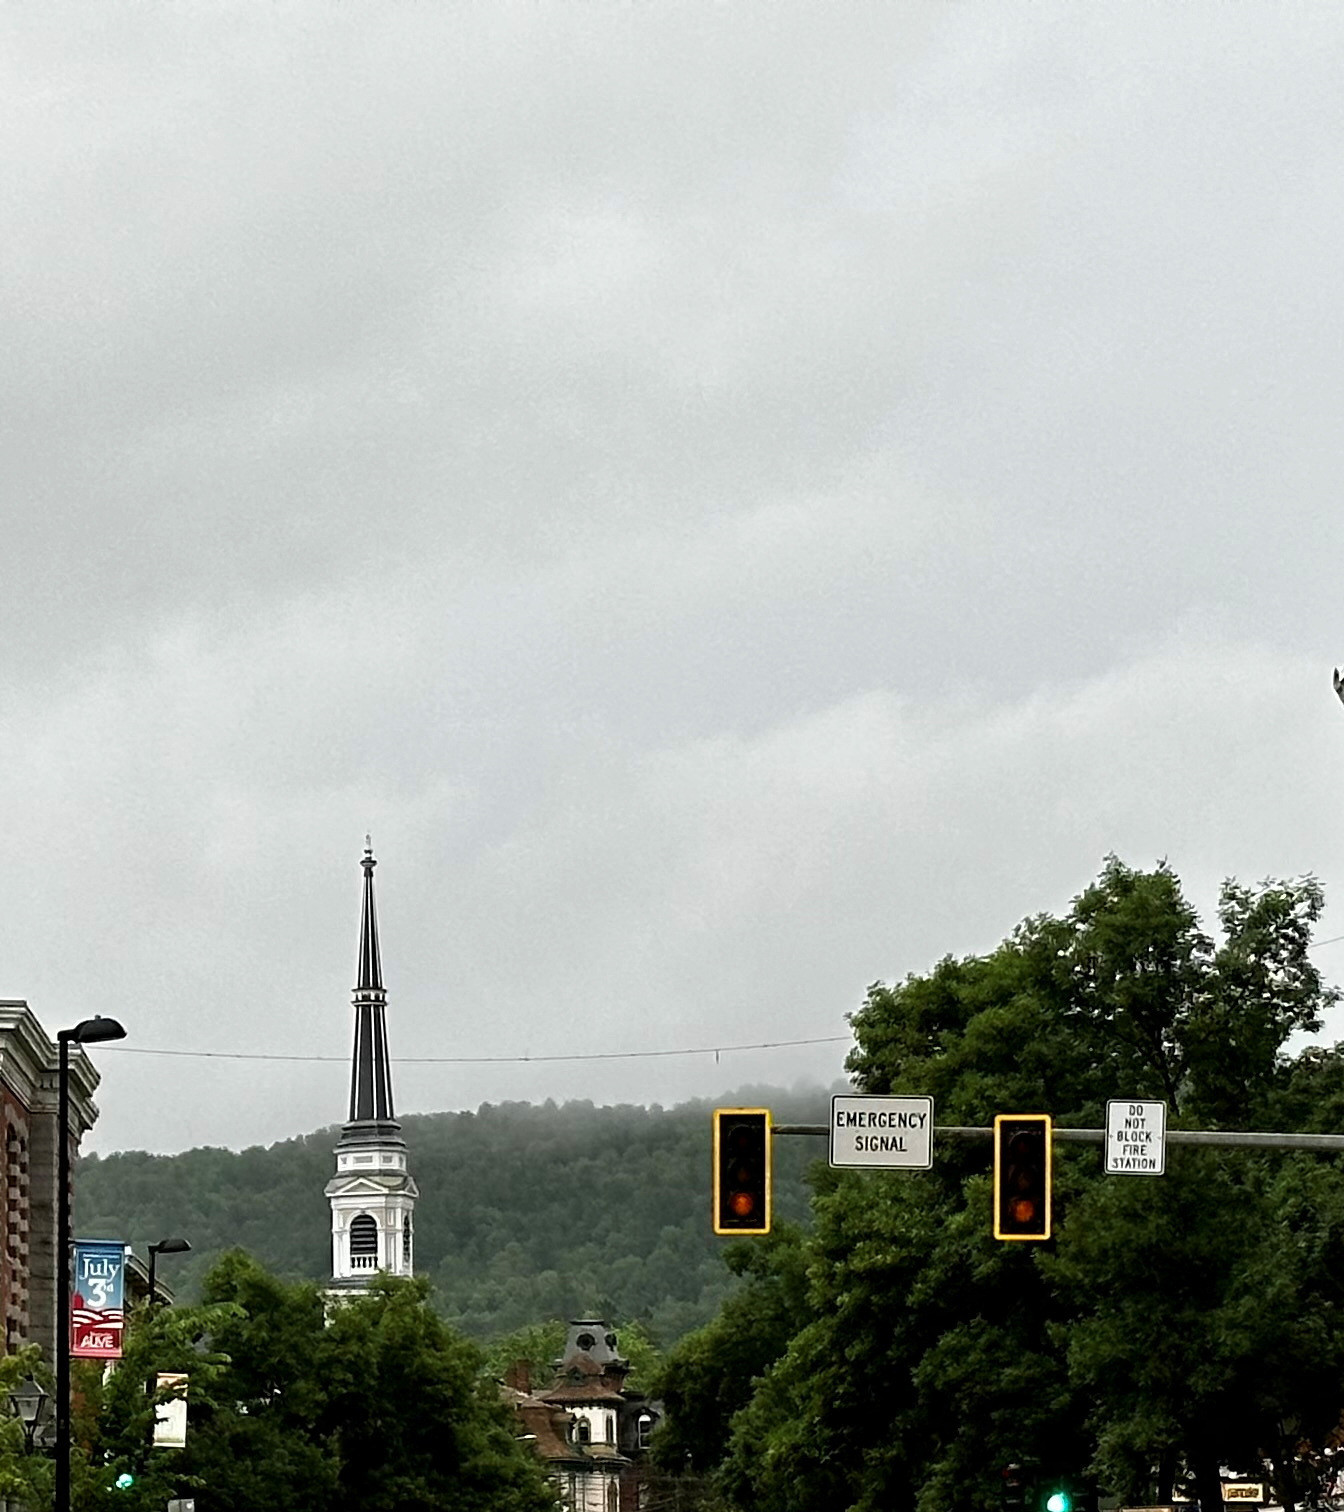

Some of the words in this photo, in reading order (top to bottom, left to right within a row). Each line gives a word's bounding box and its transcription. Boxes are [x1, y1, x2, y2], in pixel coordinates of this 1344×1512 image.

[1128, 1104, 1144, 1117] DO
[836, 1111, 927, 1129] EMERGENCY
[1124, 1117, 1146, 1130] NOT
[1116, 1130, 1153, 1143] BLOCK
[854, 1135, 908, 1152] SIGNAL
[1122, 1143, 1148, 1156] FIRE
[1111, 1156, 1157, 1170] STATION
[78, 1258, 121, 1284] July
